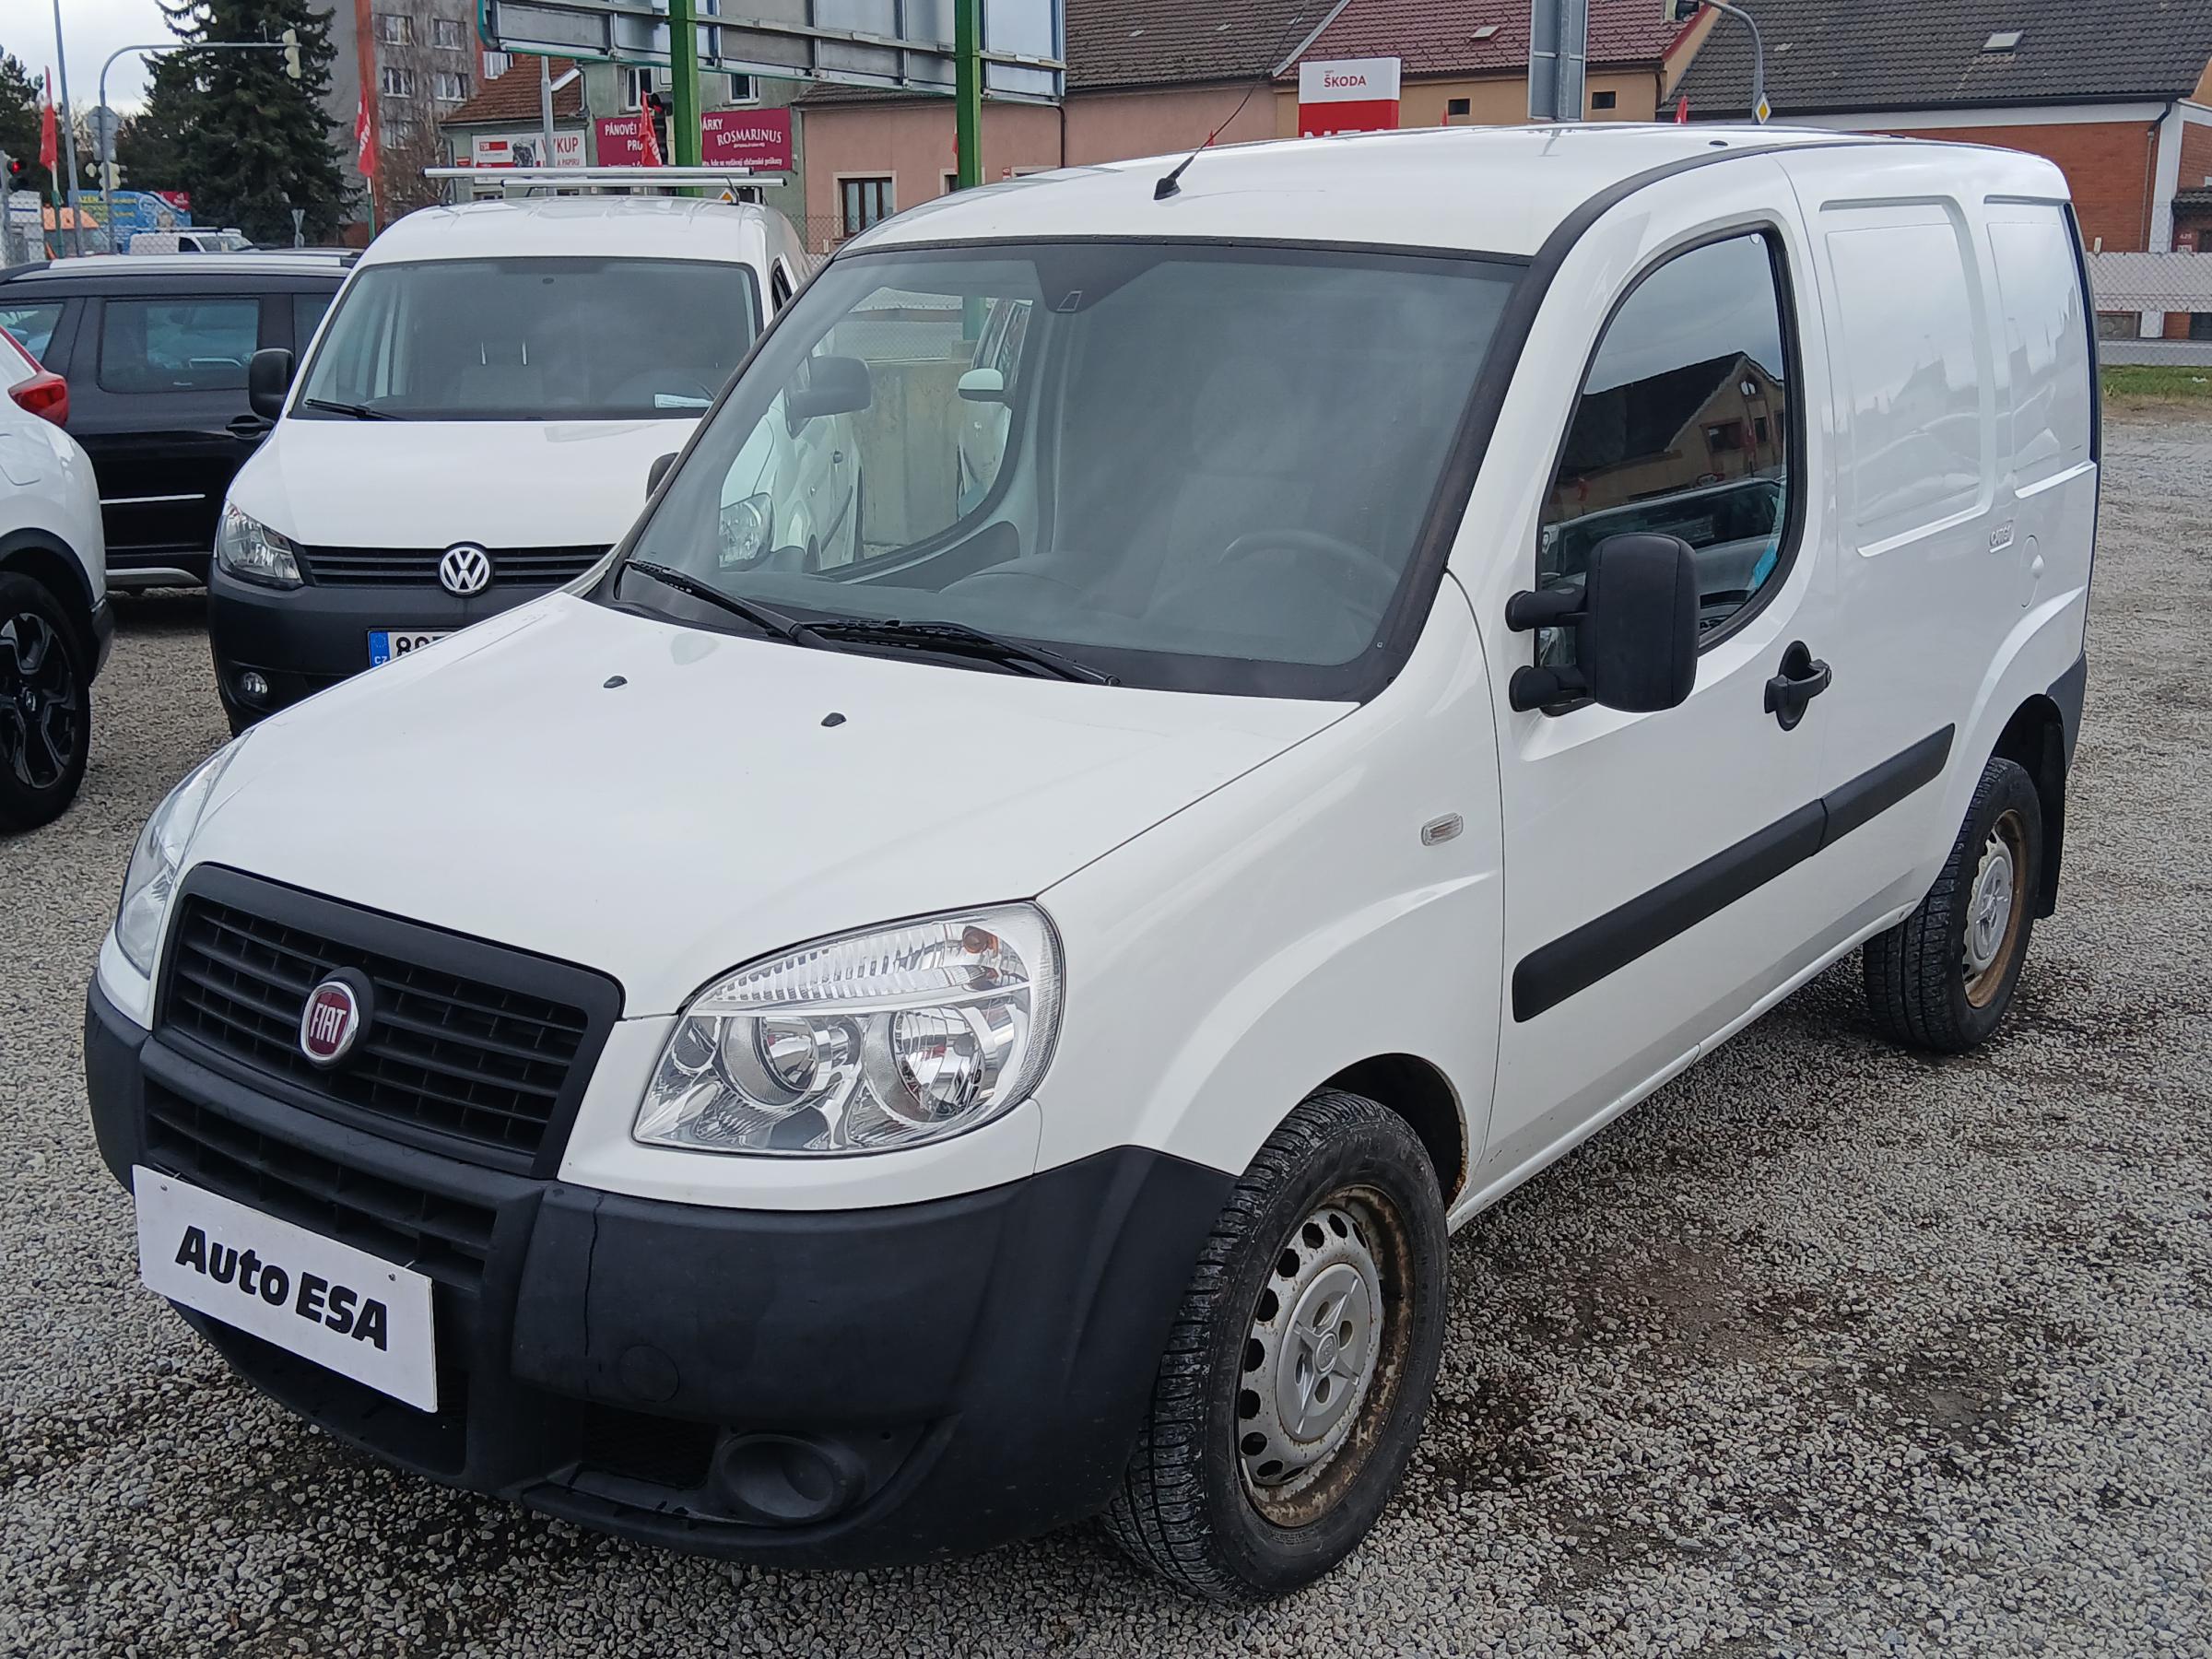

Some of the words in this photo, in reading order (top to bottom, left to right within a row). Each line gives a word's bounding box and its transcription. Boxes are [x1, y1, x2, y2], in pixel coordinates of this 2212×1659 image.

[1324, 75, 1367, 88] ŠKODA
[701, 116, 724, 131] ÁRKY
[716, 128, 782, 147] ROSMARINUS
[309, 1002, 347, 1044] FIAT
[175, 1225, 290, 1307] Auto
[295, 1271, 388, 1352] ESA
